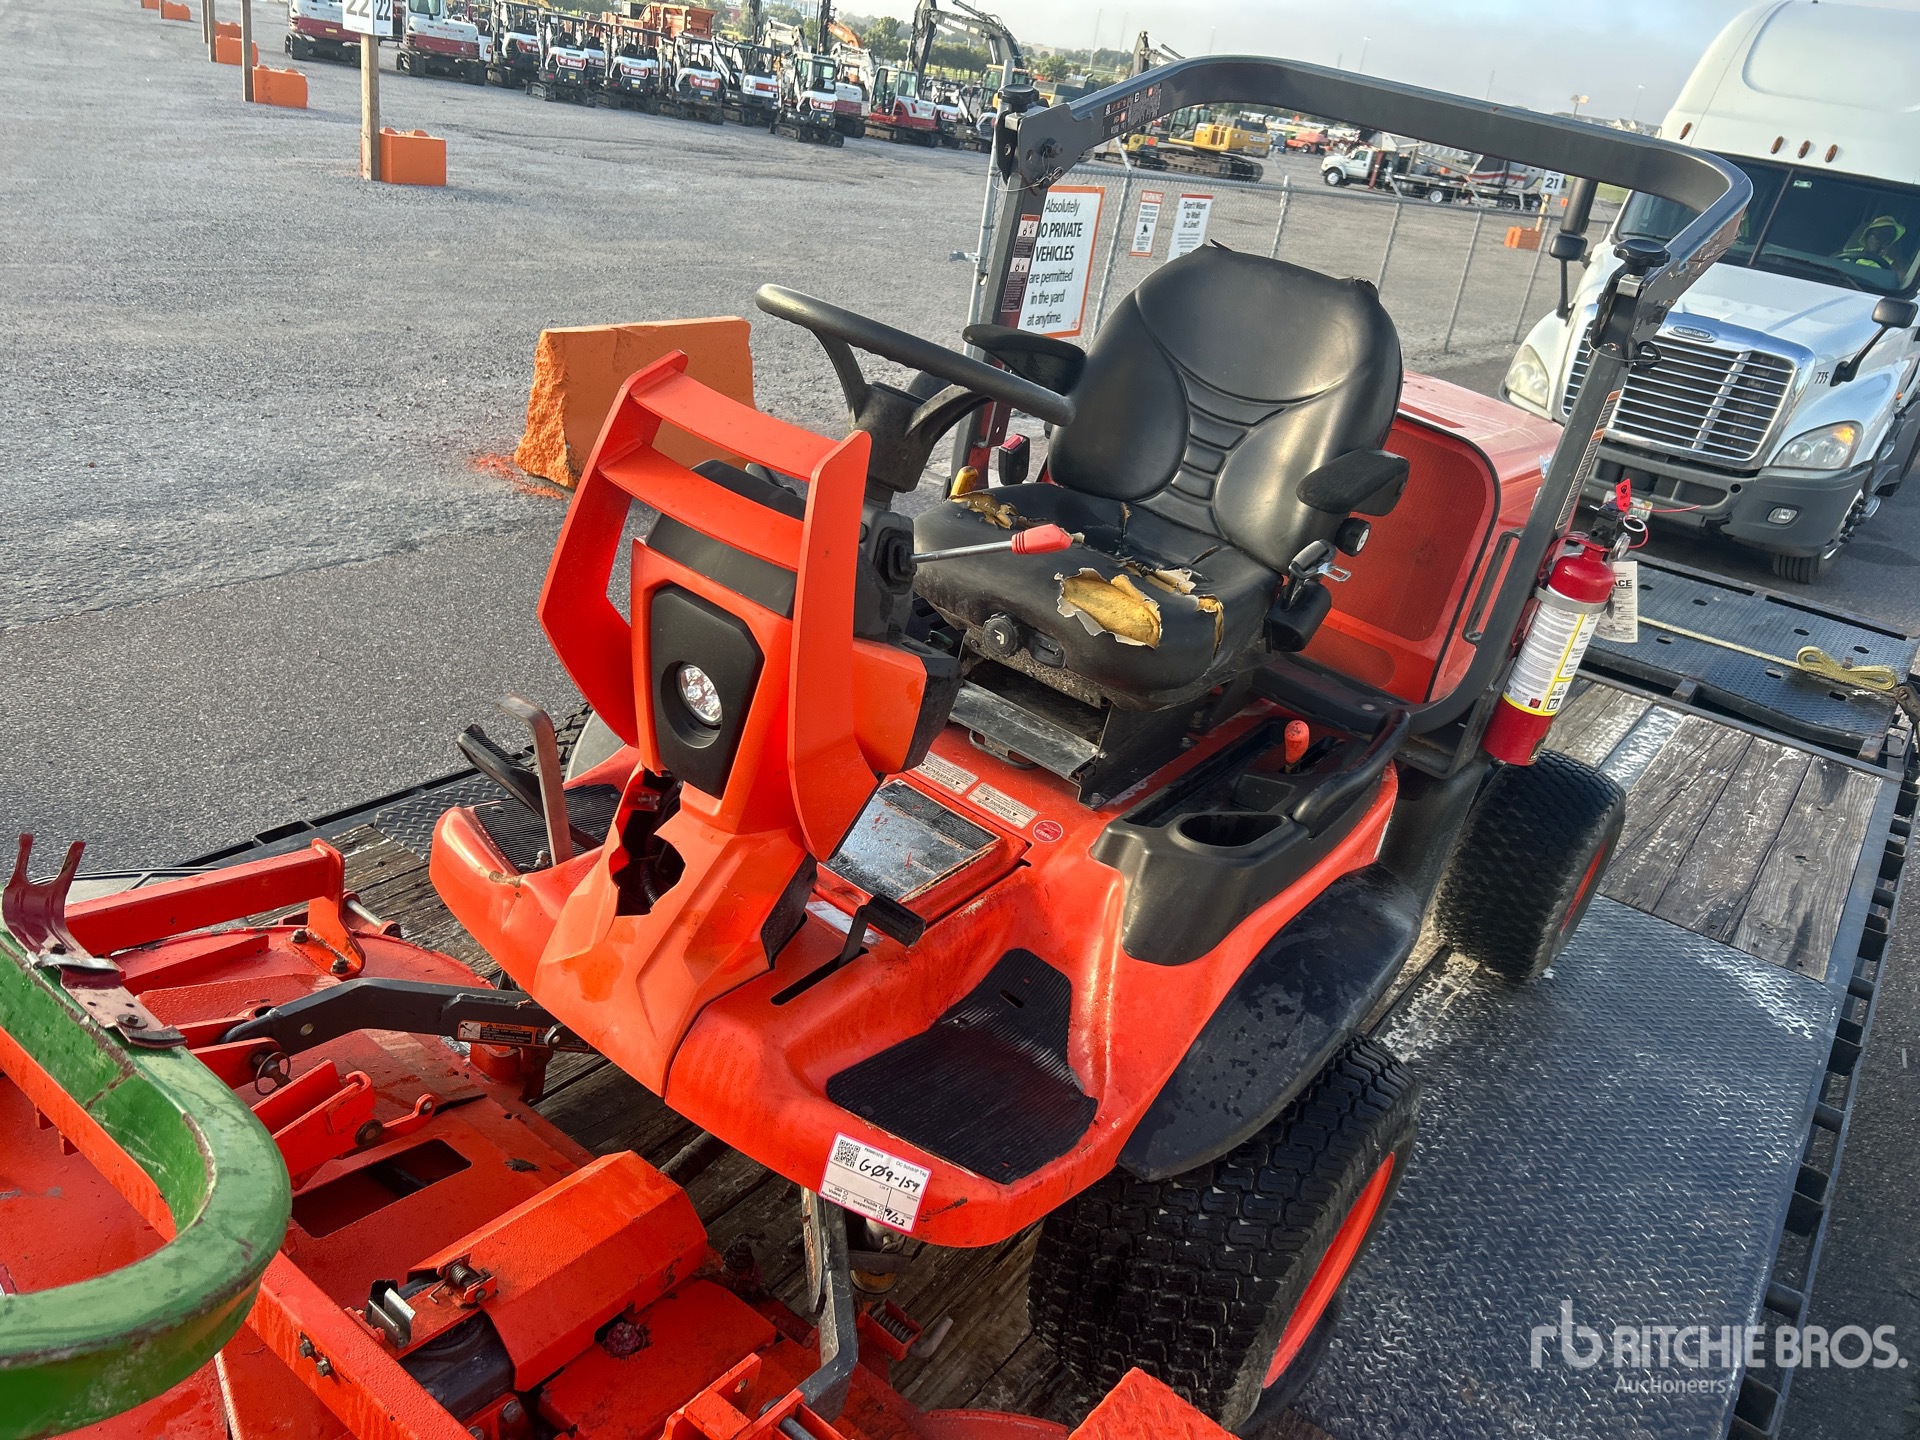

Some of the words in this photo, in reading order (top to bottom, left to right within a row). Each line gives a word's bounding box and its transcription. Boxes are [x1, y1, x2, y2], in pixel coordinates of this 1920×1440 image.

[346, 0, 371, 18] 22
[376, 0, 391, 20] 22
[1545, 178, 1558, 189] 21
[1045, 199, 1080, 216] Absolutely
[1049, 222, 1083, 238] PRIVATE
[1036, 246, 1074, 262] VEHICLES
[1029, 273, 1040, 284] are
[1040, 268, 1073, 287] permitted
[1030, 291, 1038, 305] in
[1038, 290, 1049, 303] the
[1048, 289, 1065, 306] yard
[1027, 315, 1035, 326] at
[989, 799, 1013, 815] WARNING
[828, 1188, 841, 1197] Video
[853, 1199, 877, 1212] Inspection
